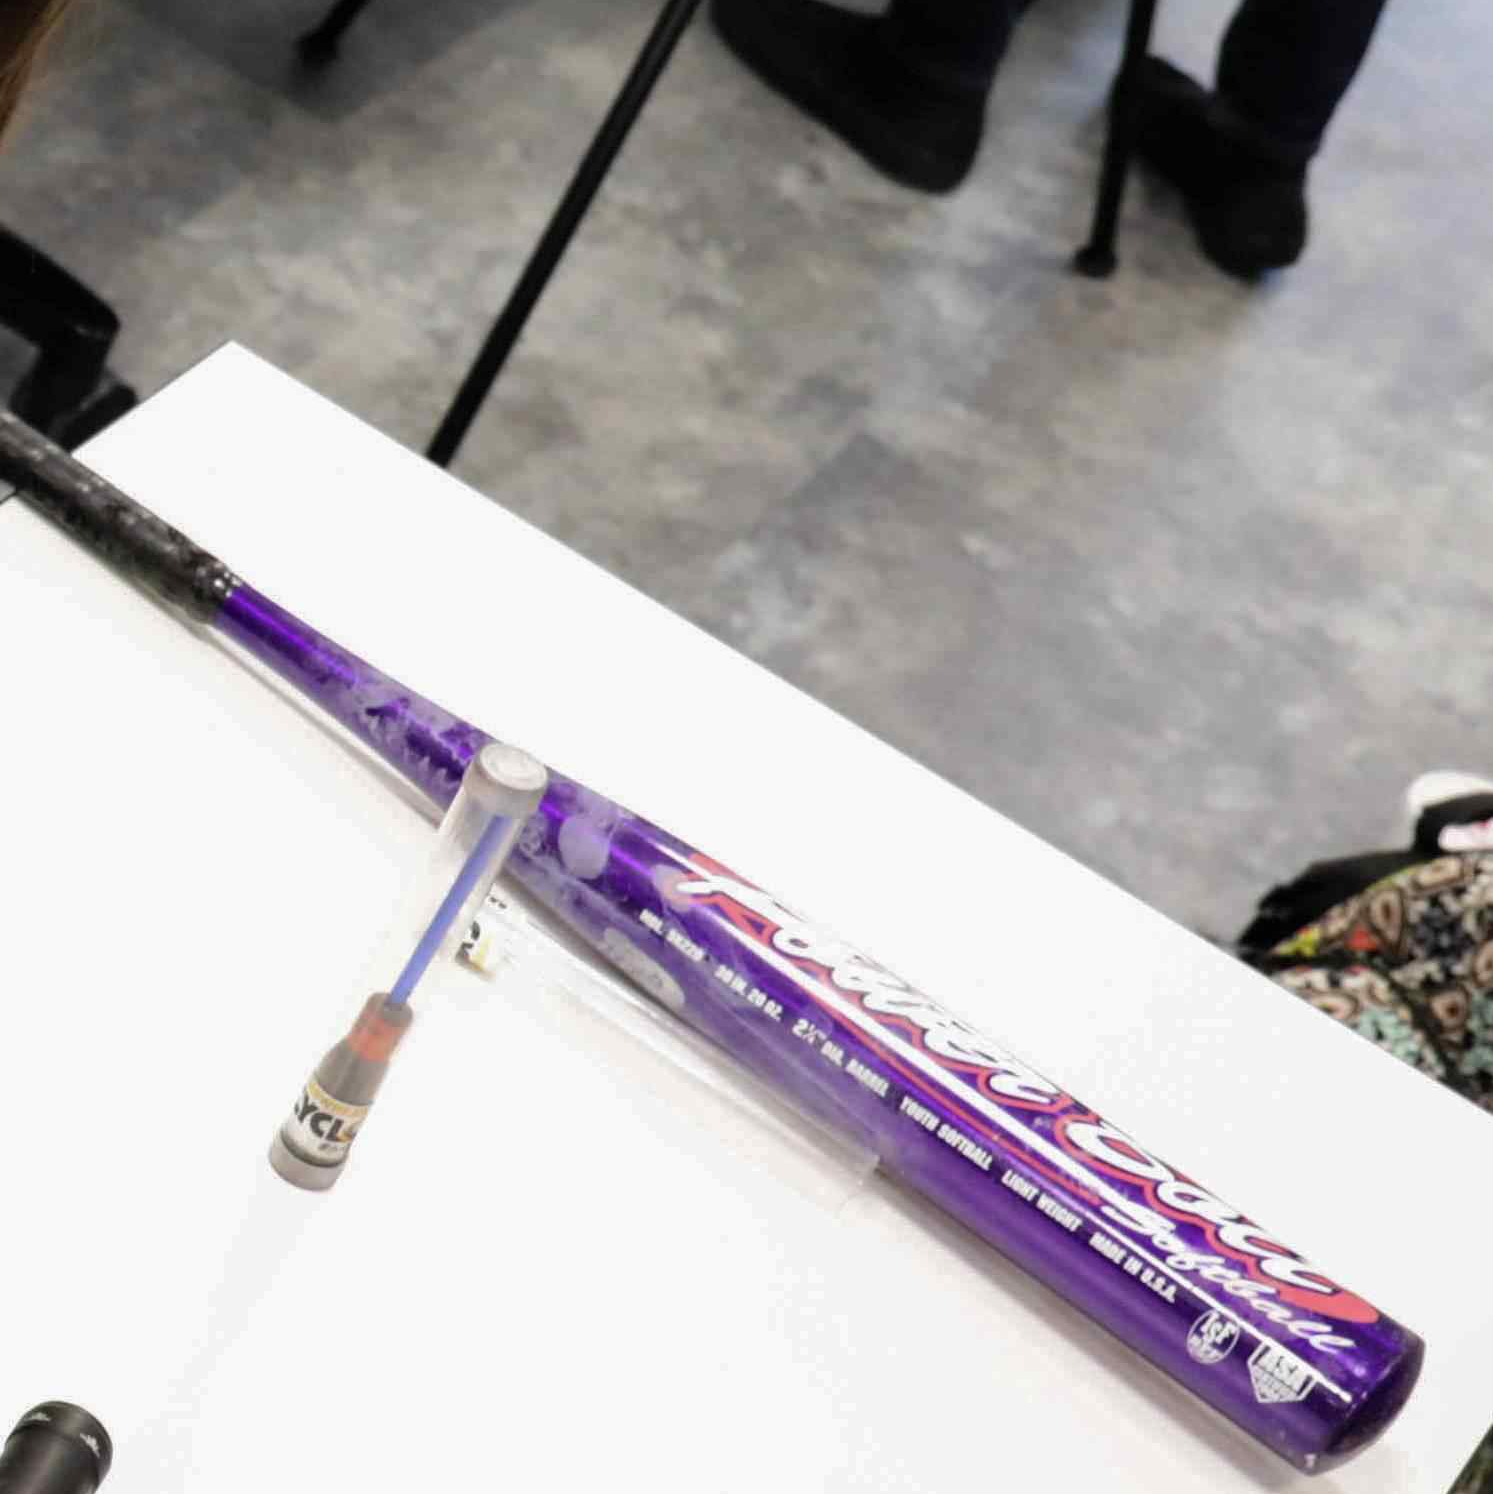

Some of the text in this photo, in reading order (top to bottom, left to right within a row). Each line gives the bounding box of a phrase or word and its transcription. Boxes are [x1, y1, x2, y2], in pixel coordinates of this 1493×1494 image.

[900, 1096, 993, 1172] YOUTH SOFTBALL
[1001, 1169, 1083, 1233] LIGHT WEIGHT
[1088, 1231, 1178, 1305] MADE IN U.S.A.
[1100, 1197, 1356, 1357] Softball
